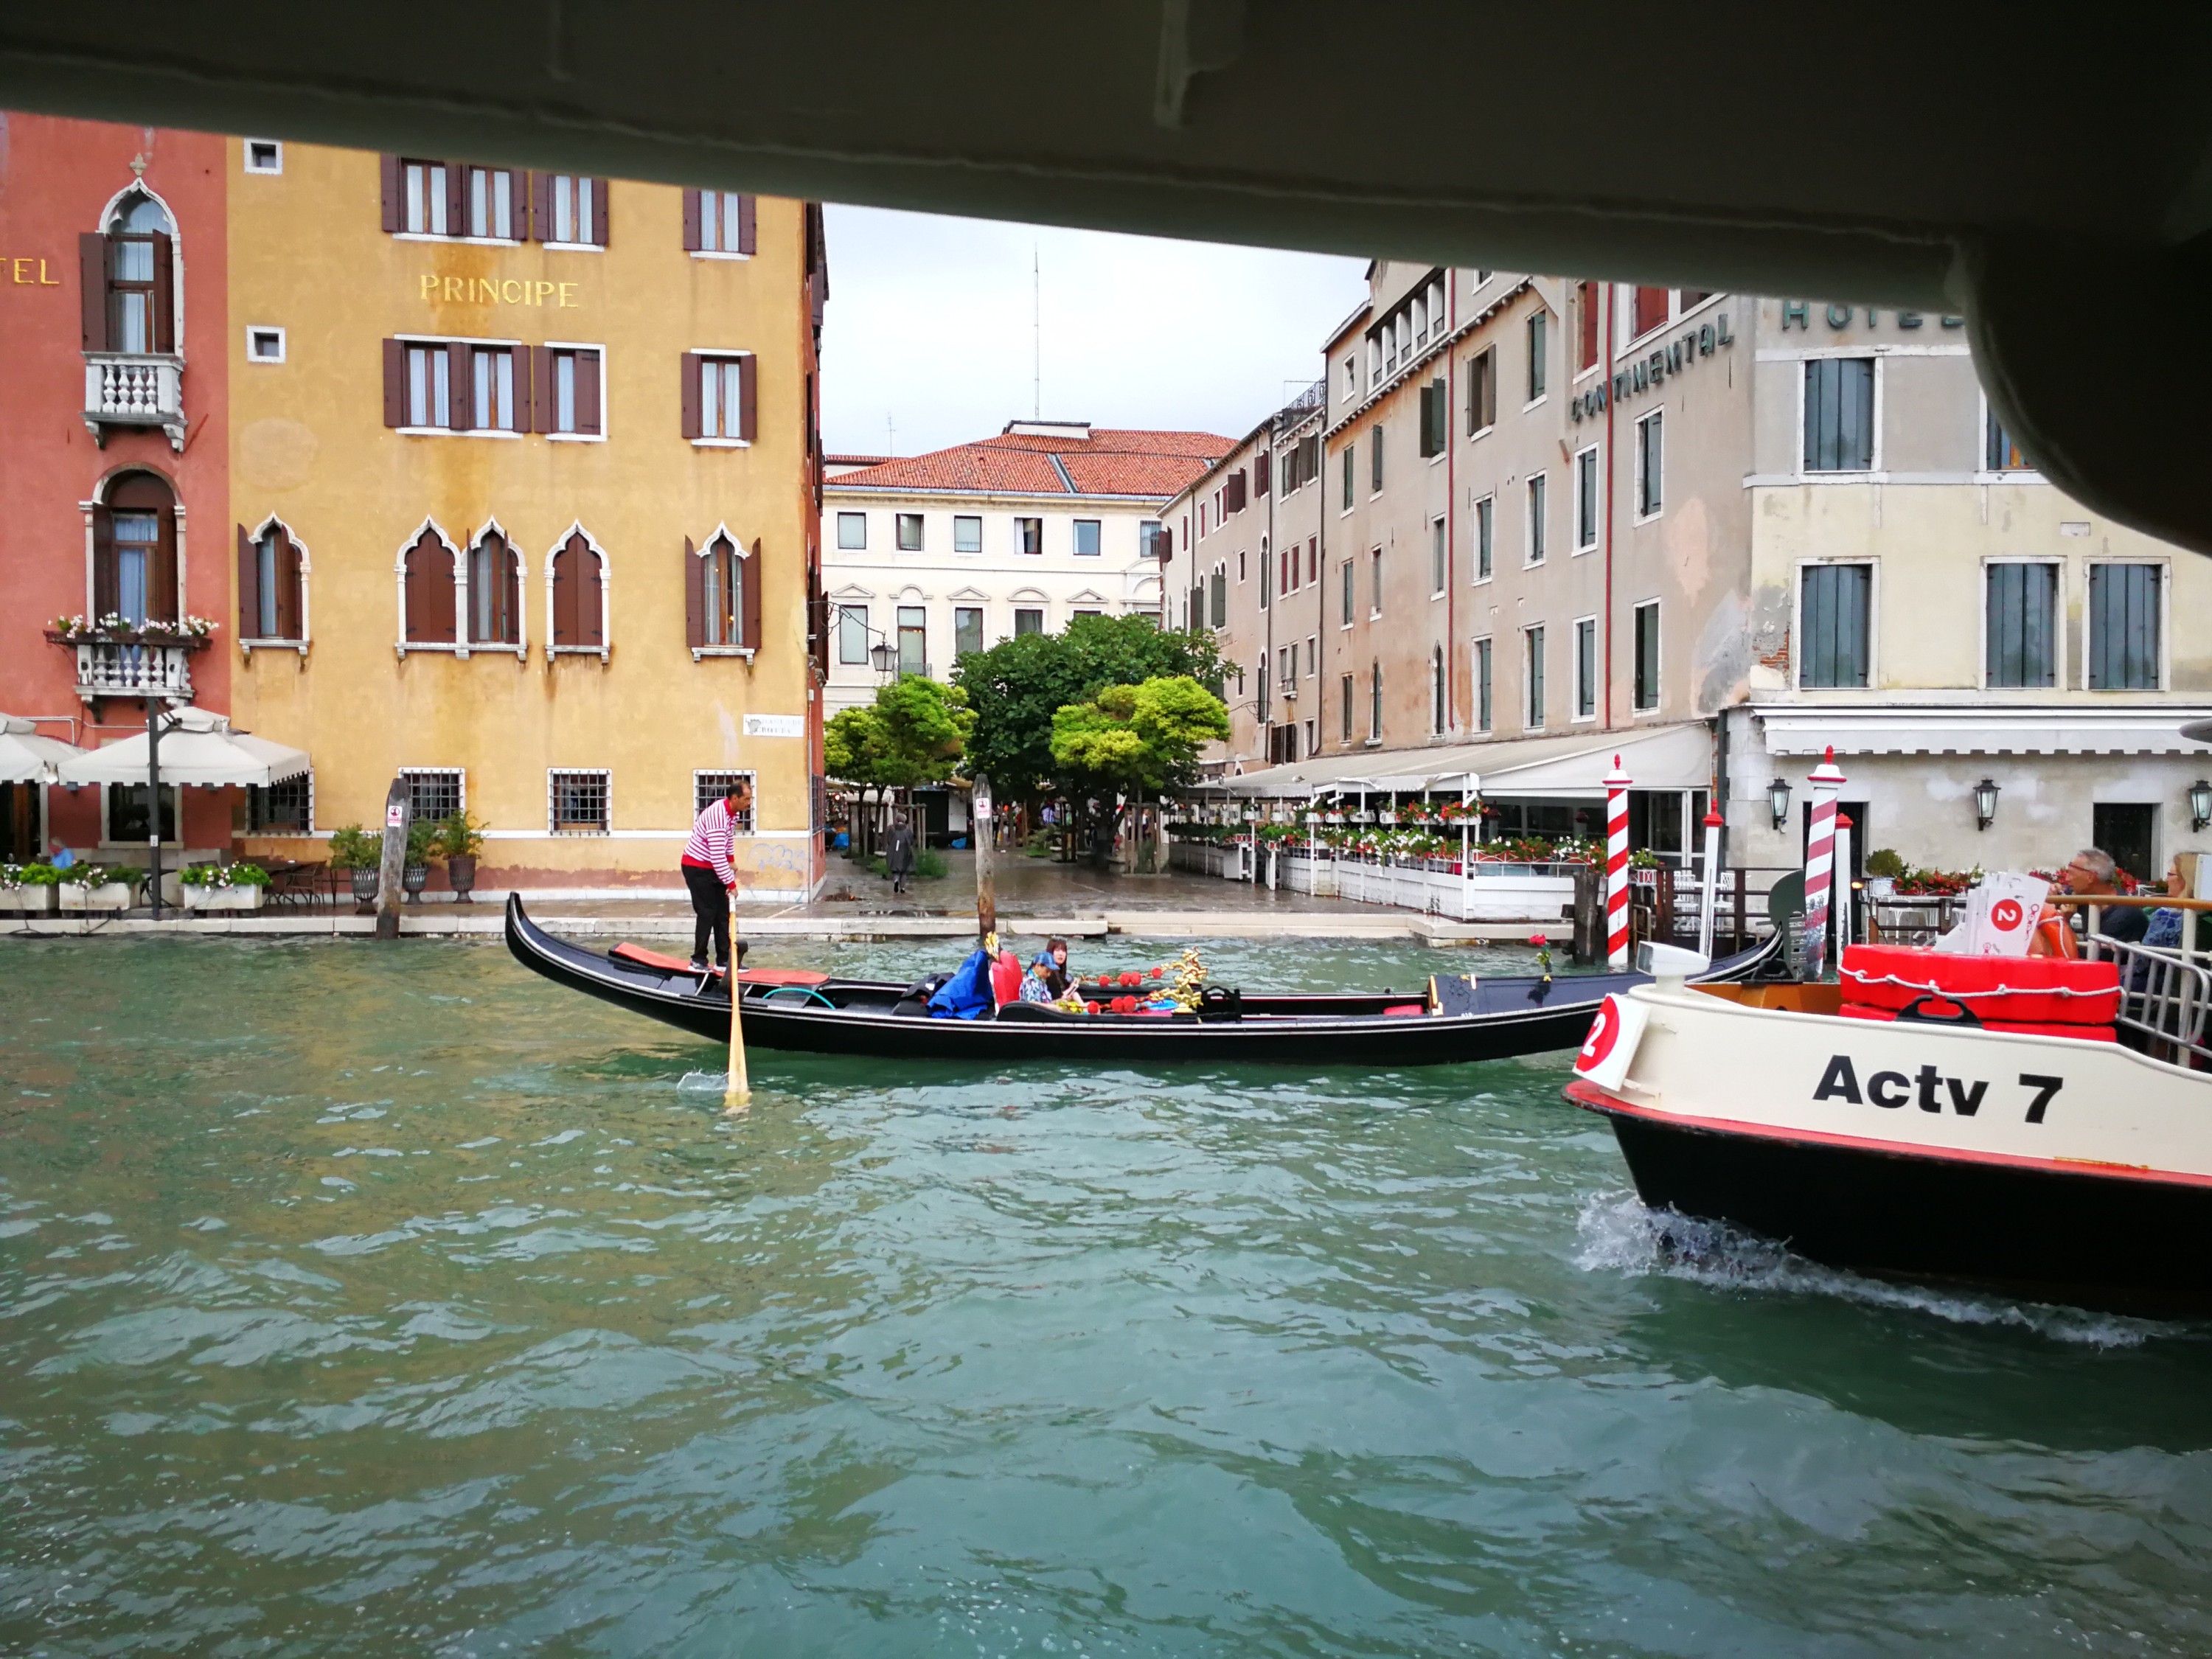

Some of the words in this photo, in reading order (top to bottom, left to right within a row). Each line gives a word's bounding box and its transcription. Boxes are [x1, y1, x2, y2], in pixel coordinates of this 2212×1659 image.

[0, 257, 60, 285] EL
[420, 274, 579, 307] PRINCIPE
[1571, 313, 1734, 423] CONTINENTAL
[1997, 908, 2017, 922] 2
[1582, 1012, 1607, 1057] 2
[1812, 1054, 1990, 1117] Actv
[2018, 1073, 2064, 1124] 7
